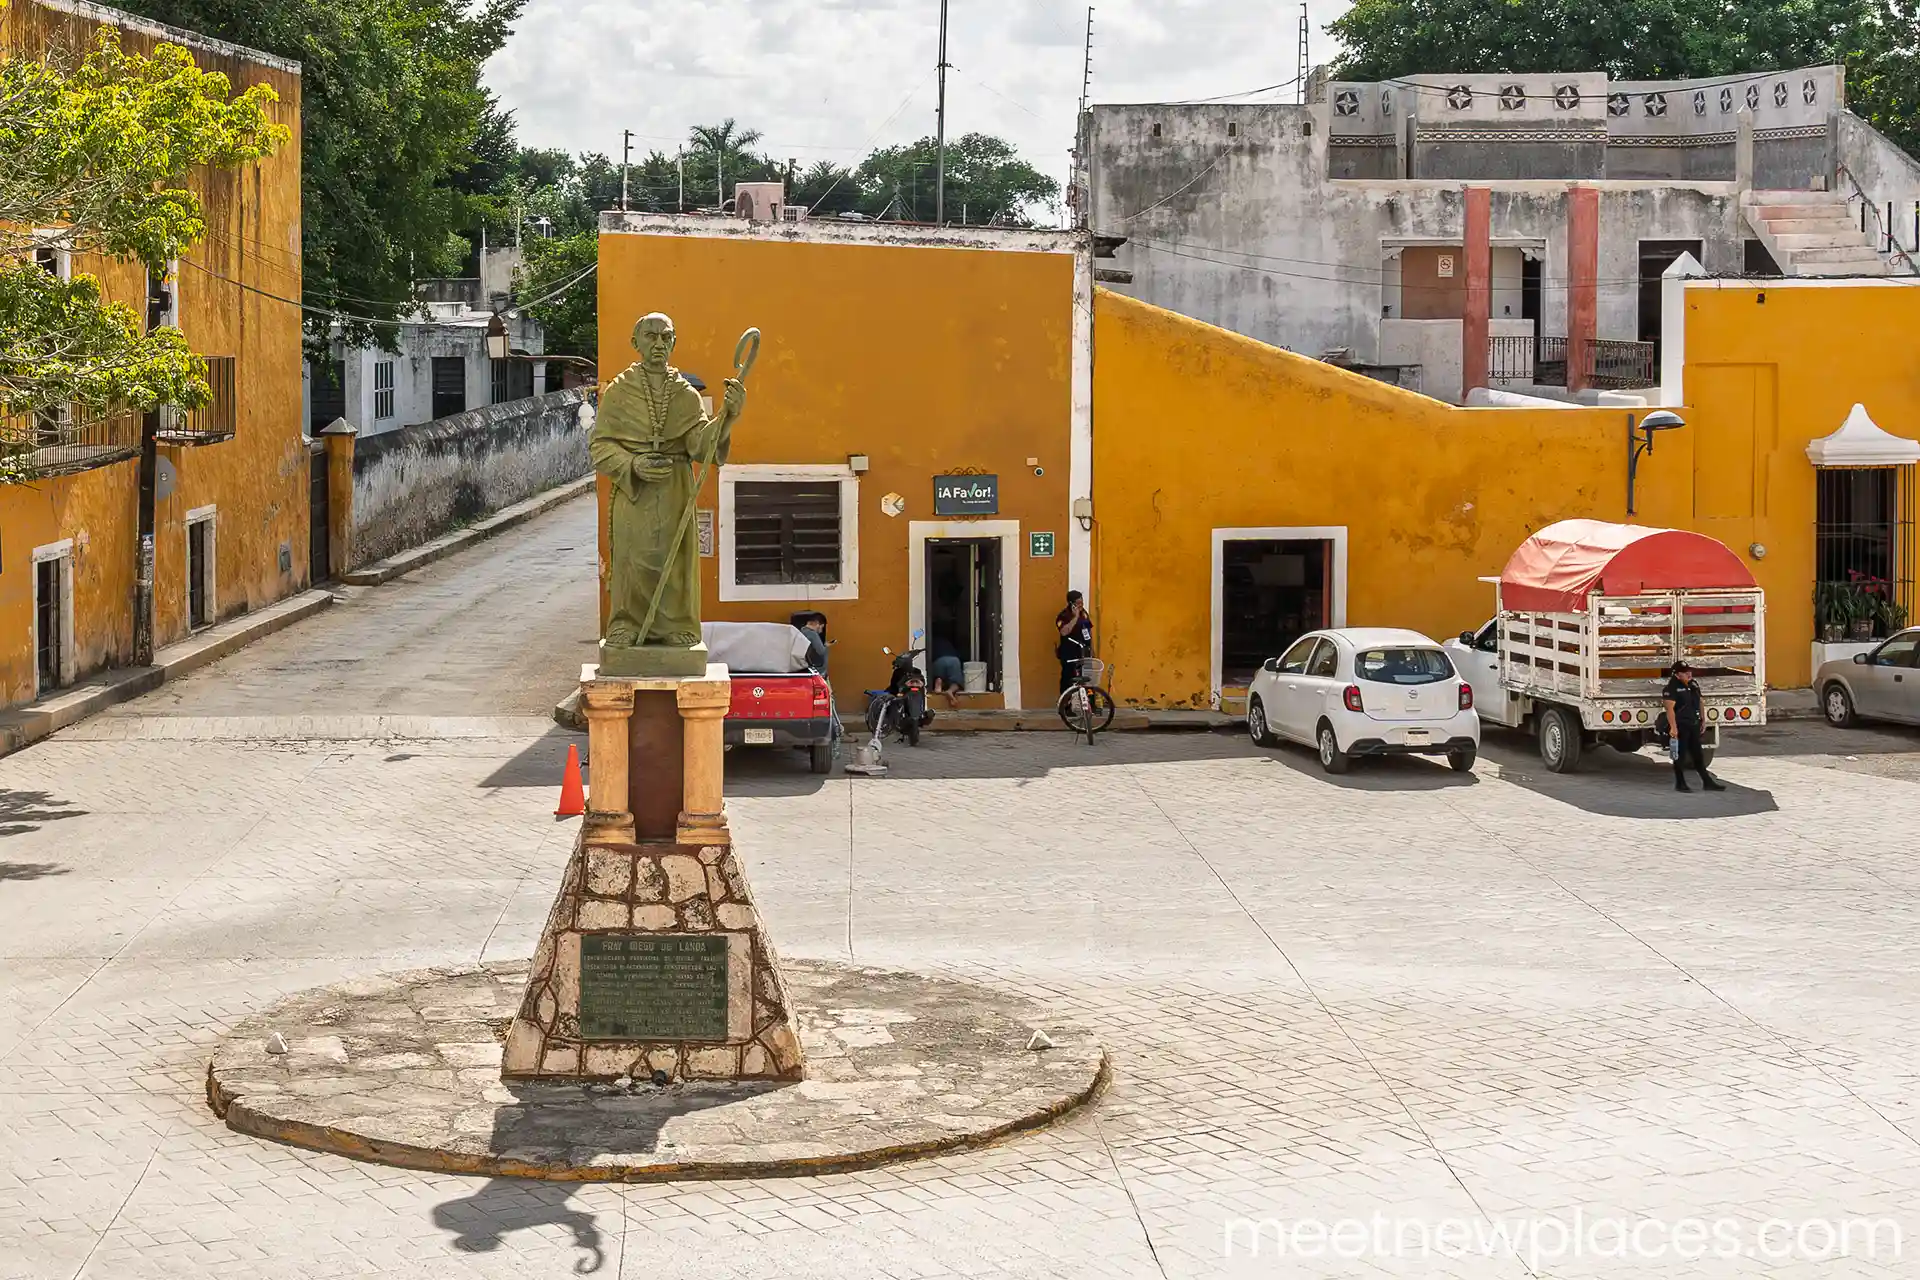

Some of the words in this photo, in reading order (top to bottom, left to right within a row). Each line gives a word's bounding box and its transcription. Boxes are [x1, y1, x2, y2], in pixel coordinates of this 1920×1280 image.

[938, 487, 952, 498] ¡A
[953, 483, 991, 498] Favor!
[602, 941, 622, 951] FRAY
[629, 941, 655, 951] DIEGO
[661, 942, 672, 952] DE
[679, 942, 706, 952] LANDA
